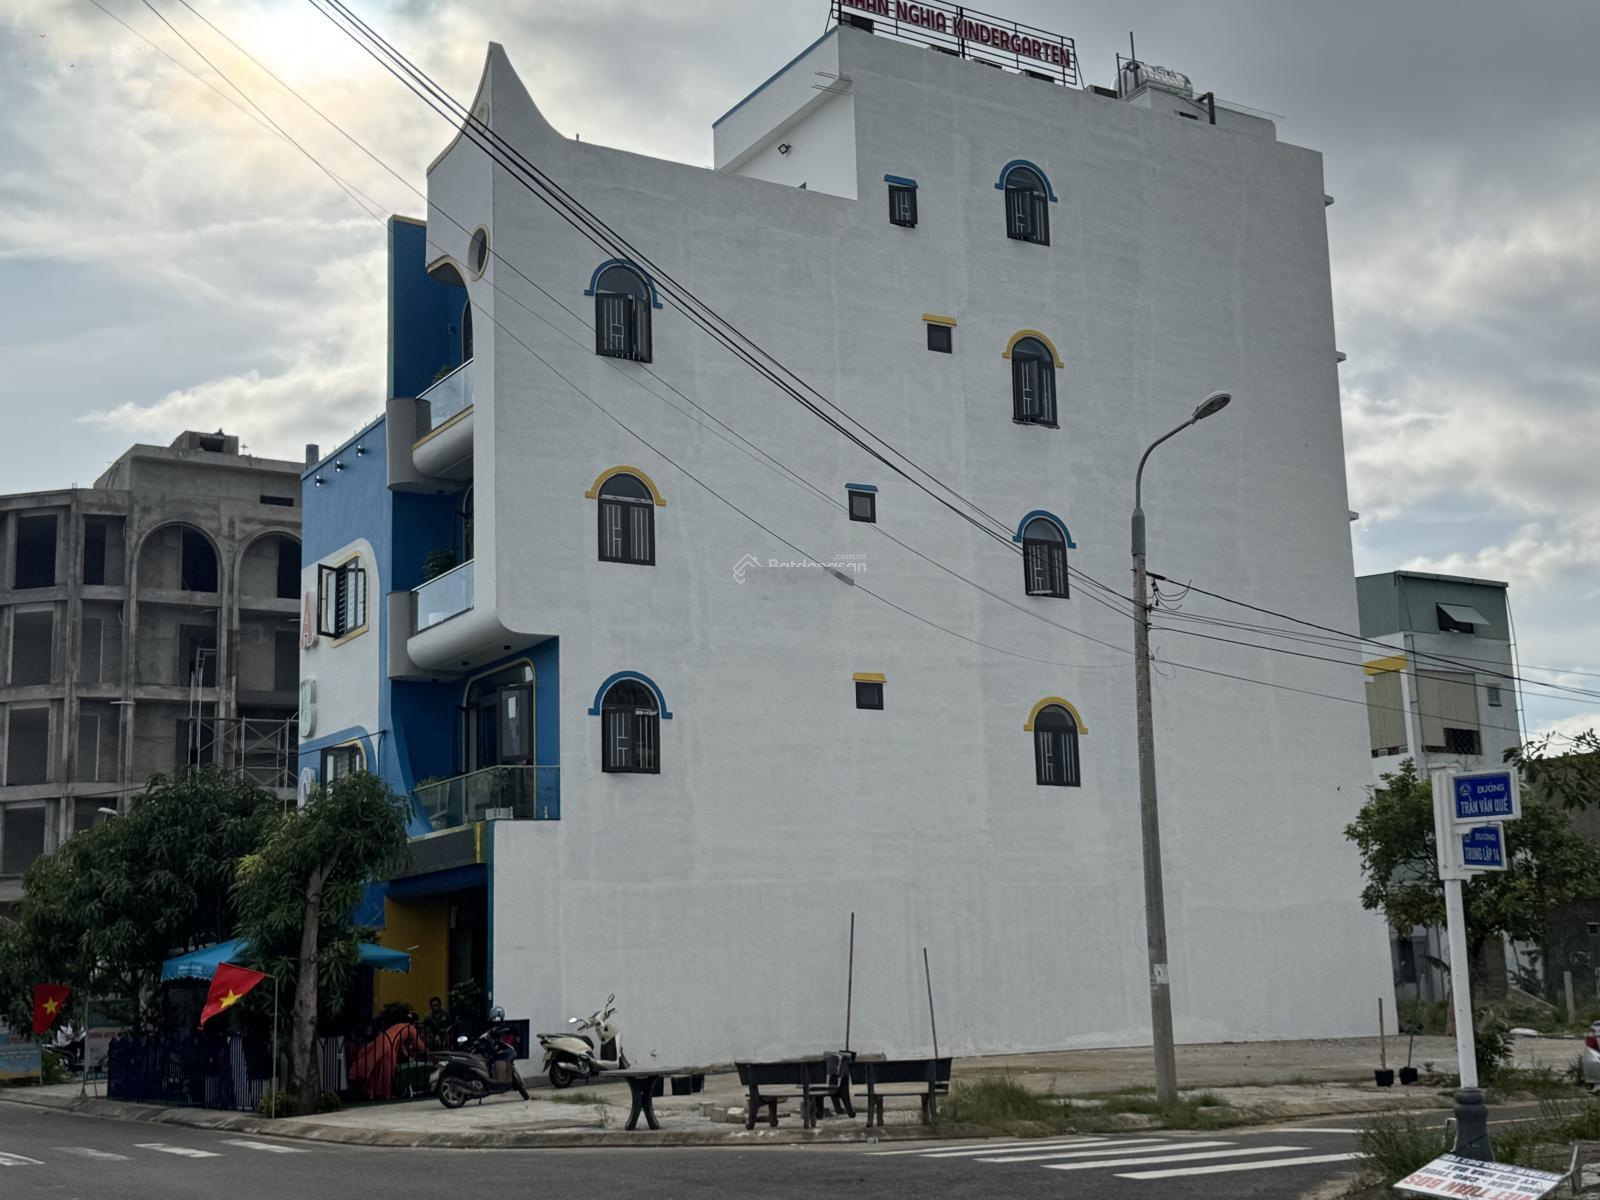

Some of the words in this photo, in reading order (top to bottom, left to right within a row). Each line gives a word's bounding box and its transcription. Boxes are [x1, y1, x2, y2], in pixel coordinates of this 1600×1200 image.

[951, 16, 1071, 67] KINDERGARTEN
[1477, 782, 1505, 794] ĐƯỜNG
[1460, 795, 1479, 814] TRẦN
[1480, 797, 1494, 812] VĂN
